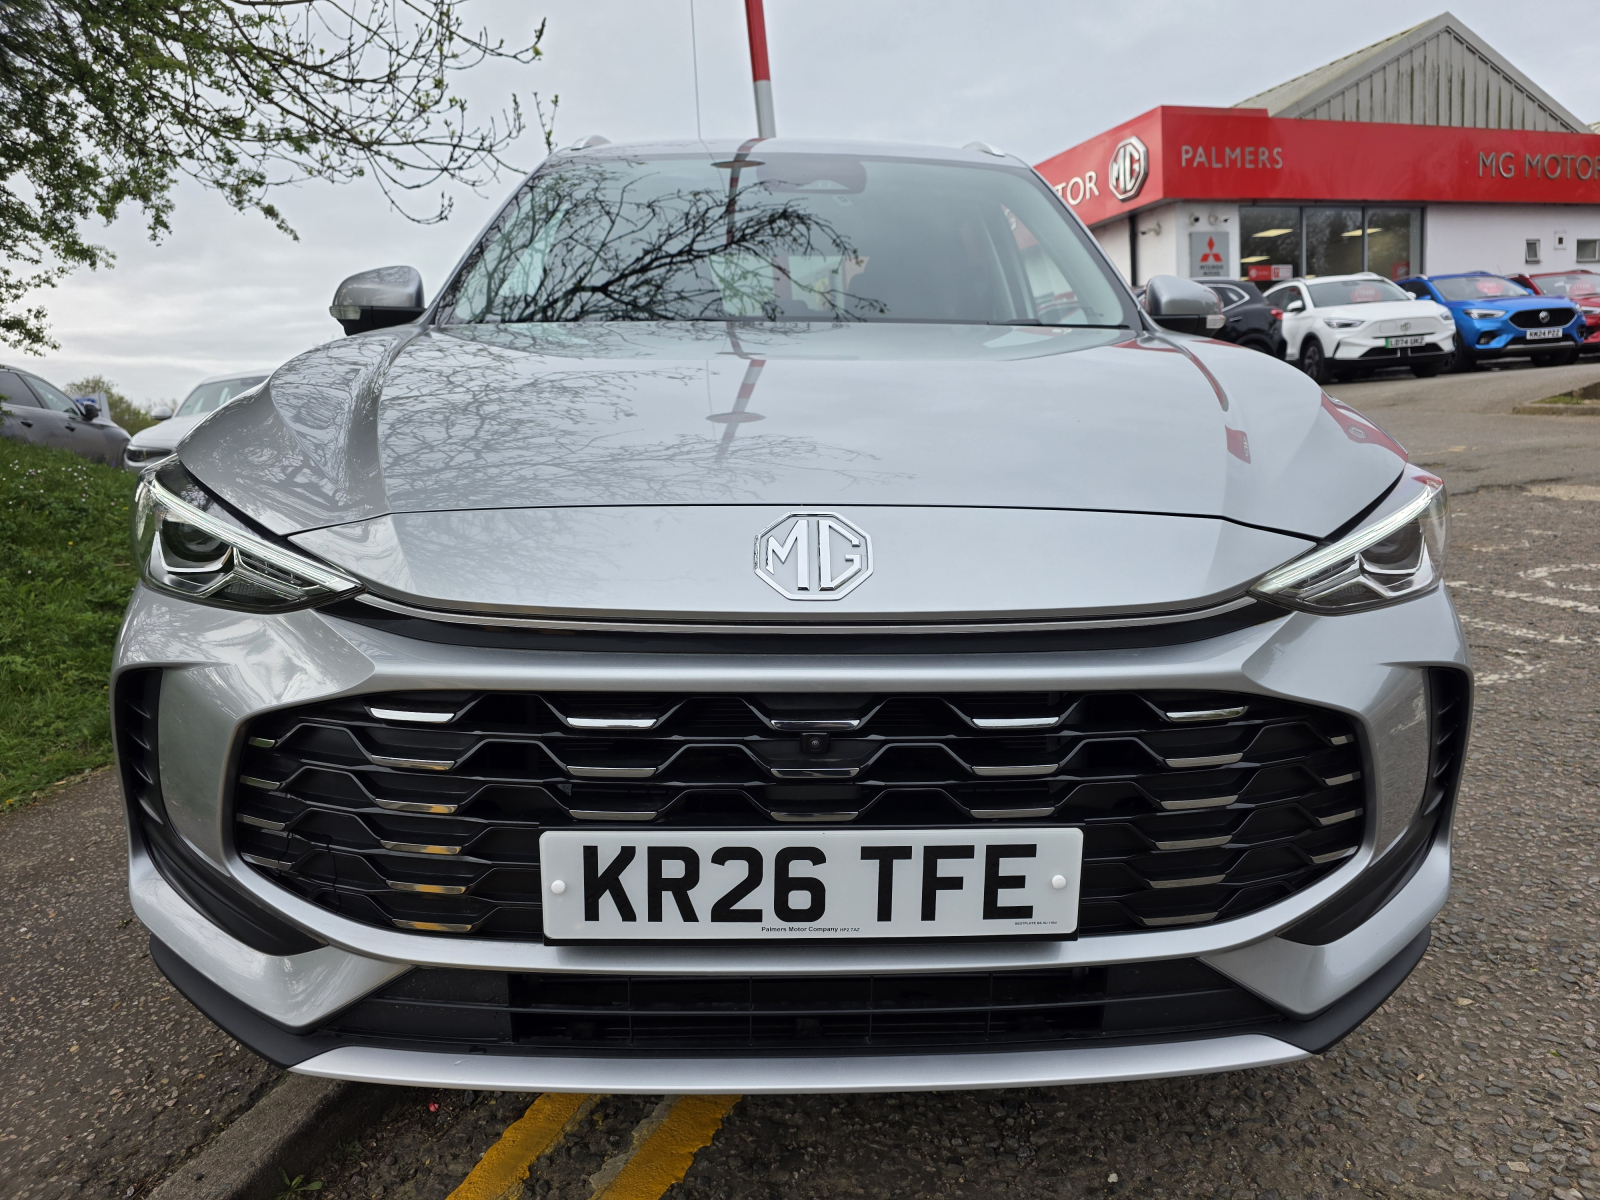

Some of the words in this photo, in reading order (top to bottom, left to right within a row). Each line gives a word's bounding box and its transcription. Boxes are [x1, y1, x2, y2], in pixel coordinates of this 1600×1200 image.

[1110, 141, 1141, 195] MG
[1181, 145, 1283, 169] PALMERS
[1478, 151, 1515, 178] MG
[765, 519, 863, 592] MG
[583, 845, 826, 922] KR26
[861, 844, 1037, 922] TFE
